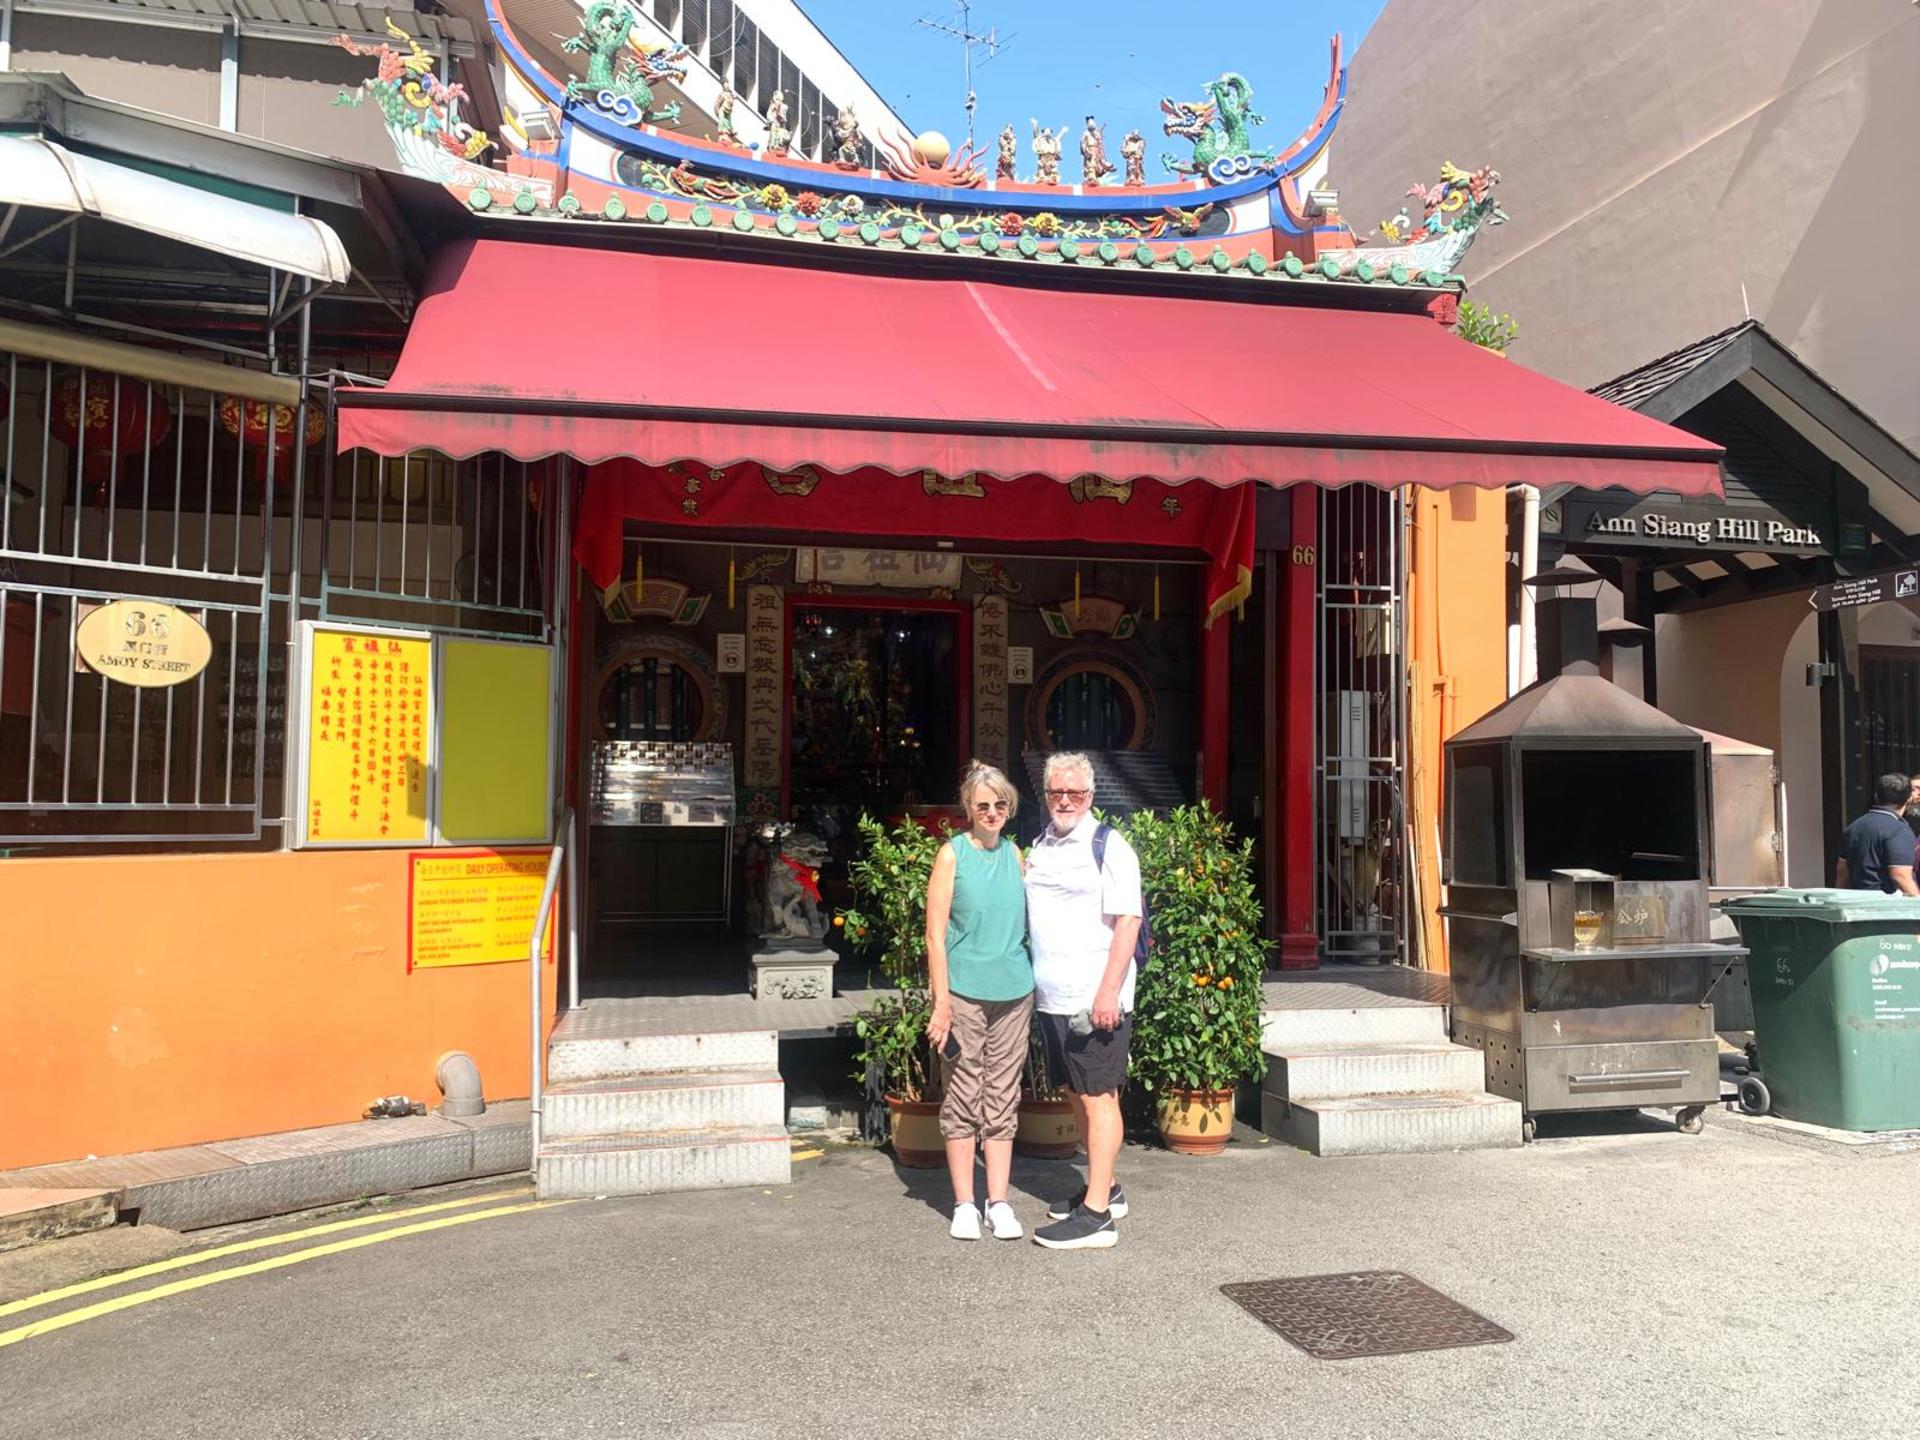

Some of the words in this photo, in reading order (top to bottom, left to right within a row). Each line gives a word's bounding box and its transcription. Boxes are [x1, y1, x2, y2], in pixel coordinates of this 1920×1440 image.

[1588, 510, 1637, 532] Ann
[1642, 513, 1711, 543] Siang
[1716, 517, 1760, 540] Hill
[1766, 520, 1821, 544] Park
[1292, 545, 1314, 565] 66
[97, 654, 138, 668] AMOY
[466, 863, 486, 875] DAILY
[486, 862, 525, 874] OPERATING
